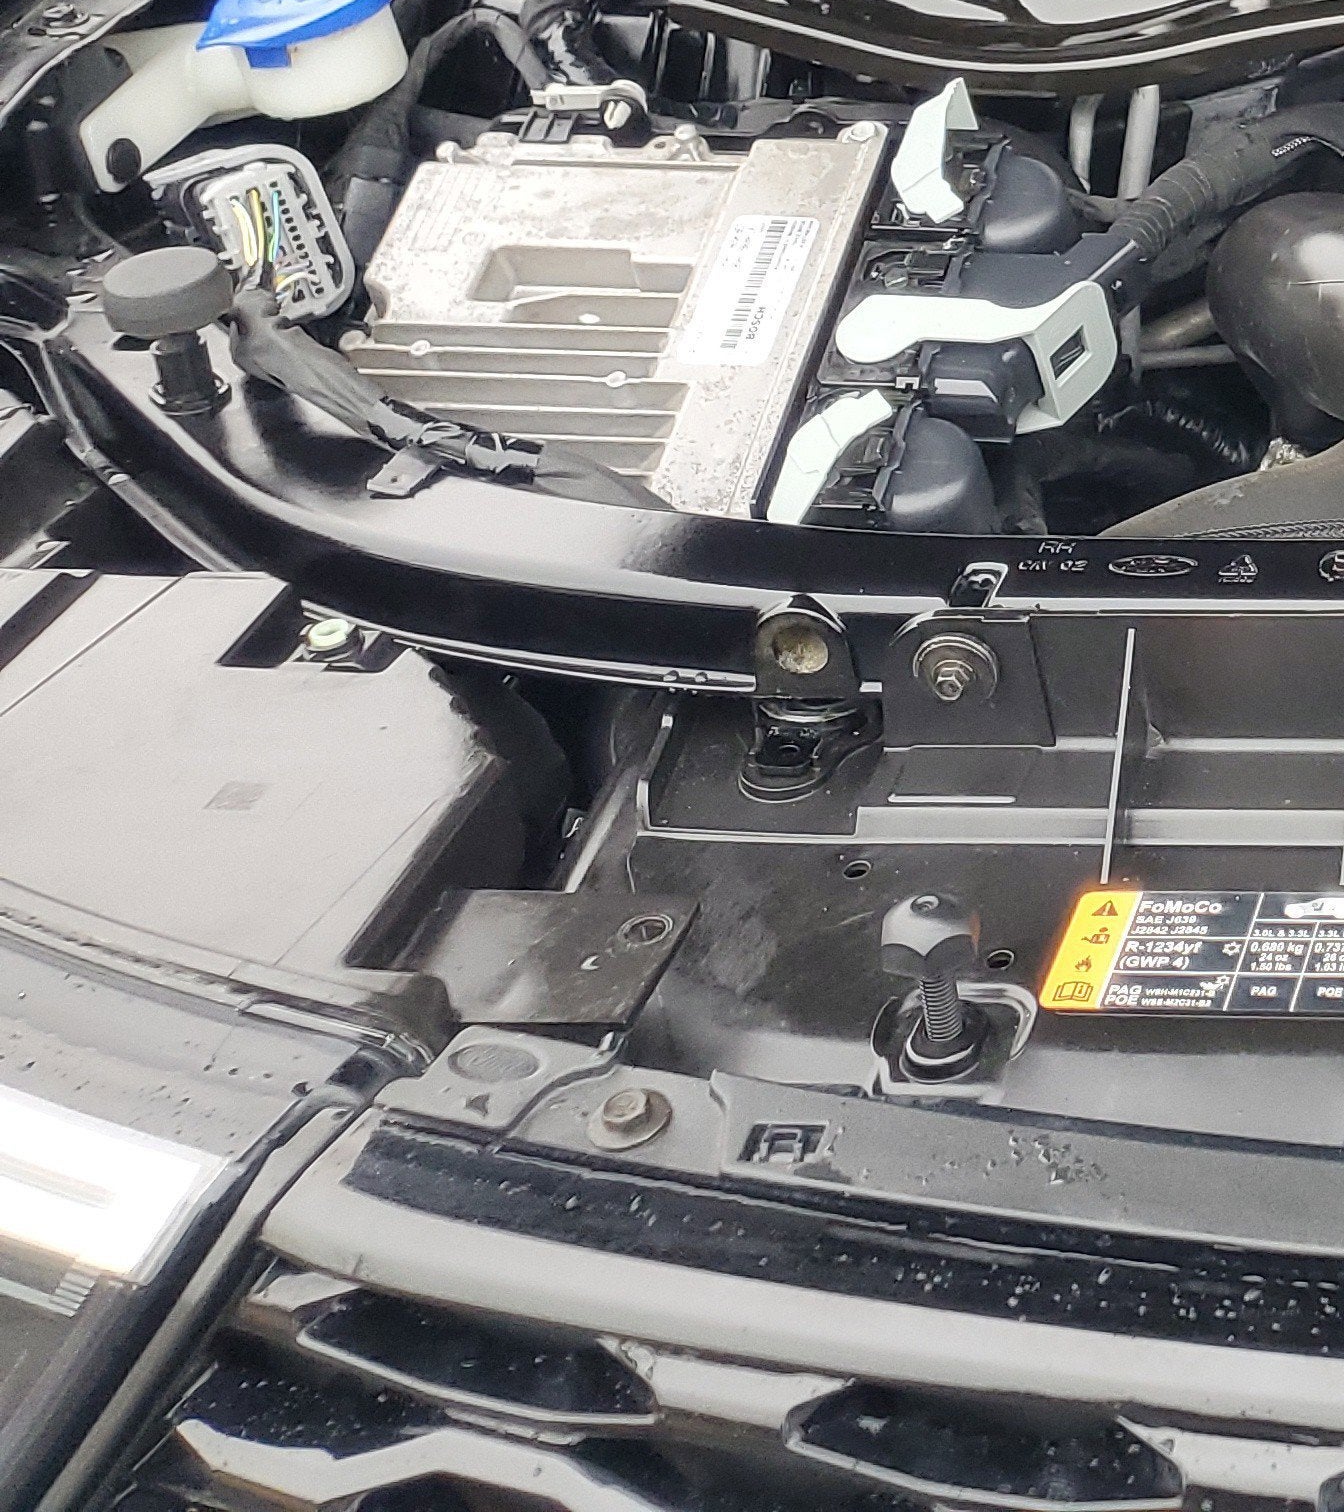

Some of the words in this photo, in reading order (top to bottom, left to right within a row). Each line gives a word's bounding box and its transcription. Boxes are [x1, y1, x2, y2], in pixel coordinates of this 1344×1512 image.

[746, 306, 766, 340] BOSCH
[1037, 540, 1077, 555] RH
[1137, 900, 1223, 914] FoMoCo
[1135, 915, 1165, 924] SAE
[1166, 915, 1197, 924] J639
[1124, 940, 1203, 955] R-1234yf
[1250, 941, 1285, 953] 0.680
[1286, 941, 1305, 956] kg
[1119, 955, 1171, 970] (GWP
[1172, 956, 1190, 970] 4)
[1258, 953, 1274, 962] 24
[1274, 954, 1289, 962] oz
[1274, 962, 1292, 971] lbs
[1108, 984, 1143, 995] PAG
[1250, 986, 1278, 997] PAG
[1316, 986, 1344, 997] POE
[1104, 994, 1139, 1005] POE
